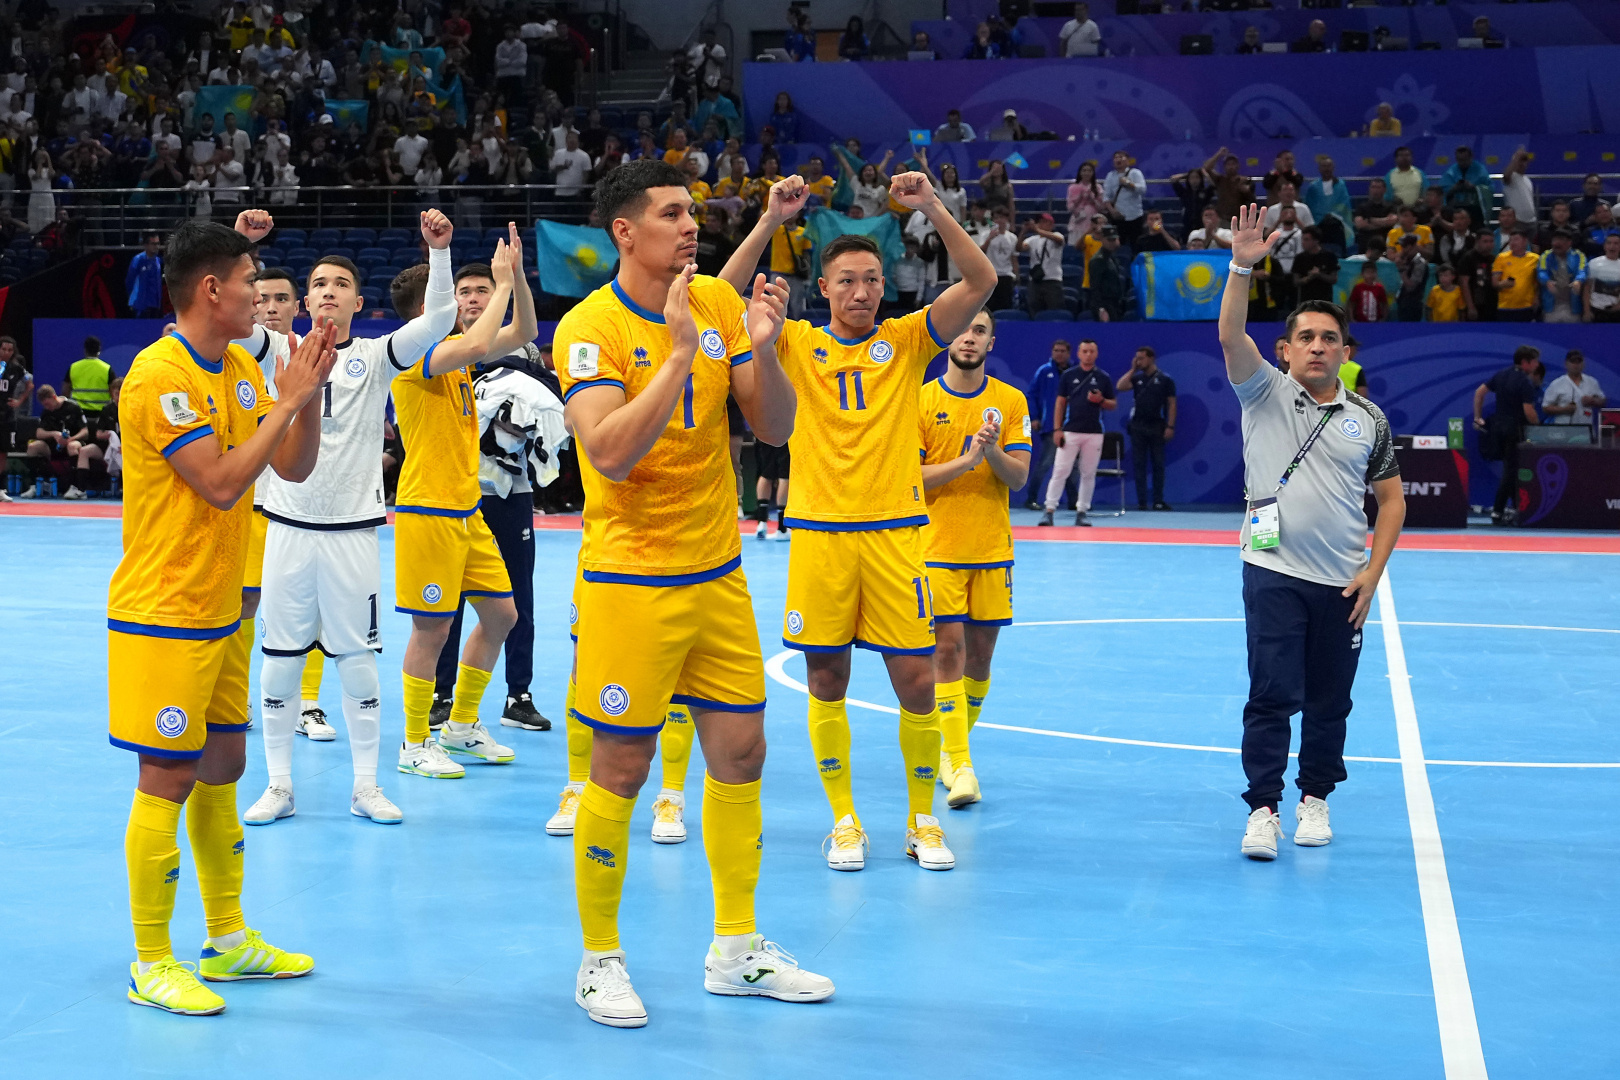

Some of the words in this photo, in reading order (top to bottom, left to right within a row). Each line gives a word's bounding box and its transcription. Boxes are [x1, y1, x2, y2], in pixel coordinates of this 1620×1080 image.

[322, 381, 333, 418] 1
[835, 371, 867, 411] 11
[1448, 421, 1464, 432] VS
[368, 592, 378, 630] 1
[912, 576, 934, 619] 11
[821, 764, 842, 773] errea
[586, 852, 616, 868] errea
